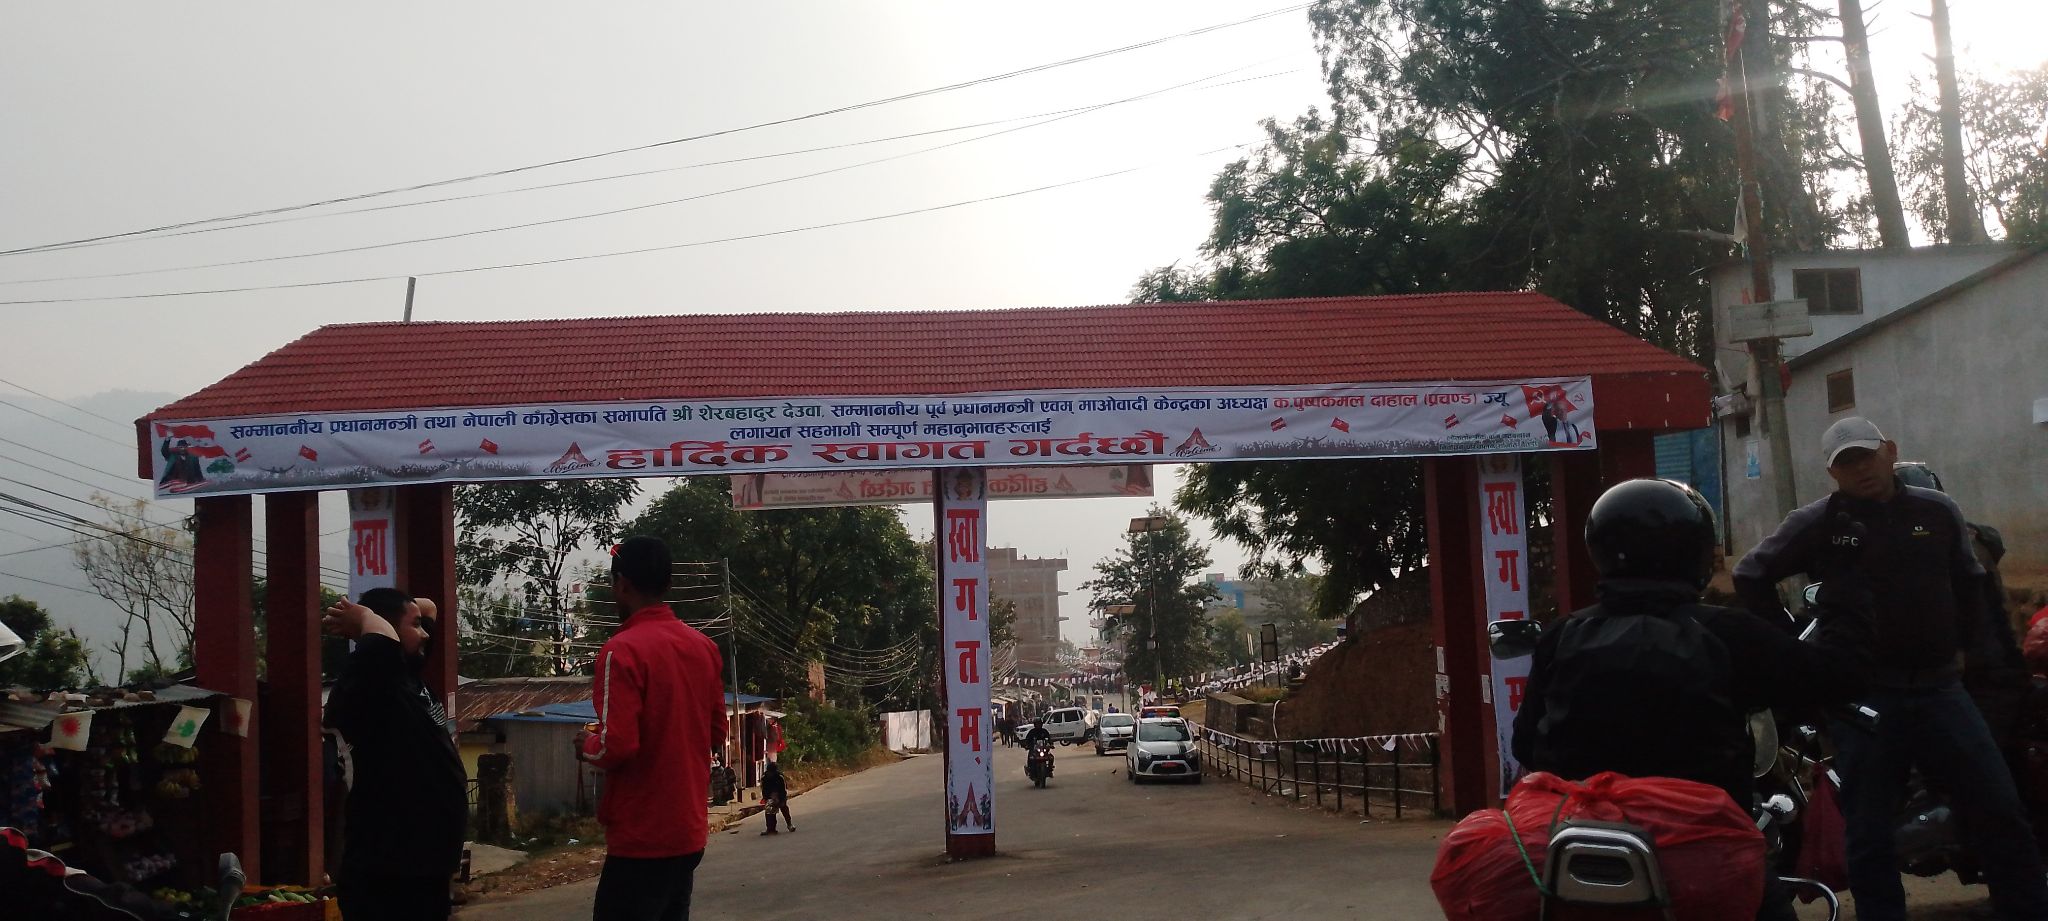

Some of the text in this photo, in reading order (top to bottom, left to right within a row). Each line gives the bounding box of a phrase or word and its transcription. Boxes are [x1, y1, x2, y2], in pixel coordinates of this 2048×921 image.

[229, 418, 323, 439] सम्माननीय
[329, 413, 419, 434] प्रधानमन्त्री
[424, 414, 457, 430] तथा
[462, 411, 517, 429] नेपाली
[602, 406, 667, 424] सभापति
[671, 406, 693, 422] श्री
[698, 403, 777, 422] शेरबहादुर
[830, 401, 919, 419] सम्माननीय
[925, 402, 947, 420] पूर्व
[952, 397, 1035, 416] प्रधानमन्त्री
[1039, 399, 1075, 416] एवम्
[1078, 396, 1148, 412] माओवादी
[1153, 395, 1211, 412] केन्द्रका
[1219, 396, 1268, 411] अध्यक्ष
[1370, 393, 1418, 408] दाहाल
[729, 427, 792, 440] लगायत
[796, 420, 862, 438] सहभागी
[866, 420, 918, 439] सम्पूर्ण
[606, 440, 792, 470] हार्दिक
[811, 440, 990, 463] स्वागत
[1832, 535, 1859, 547] UFC
